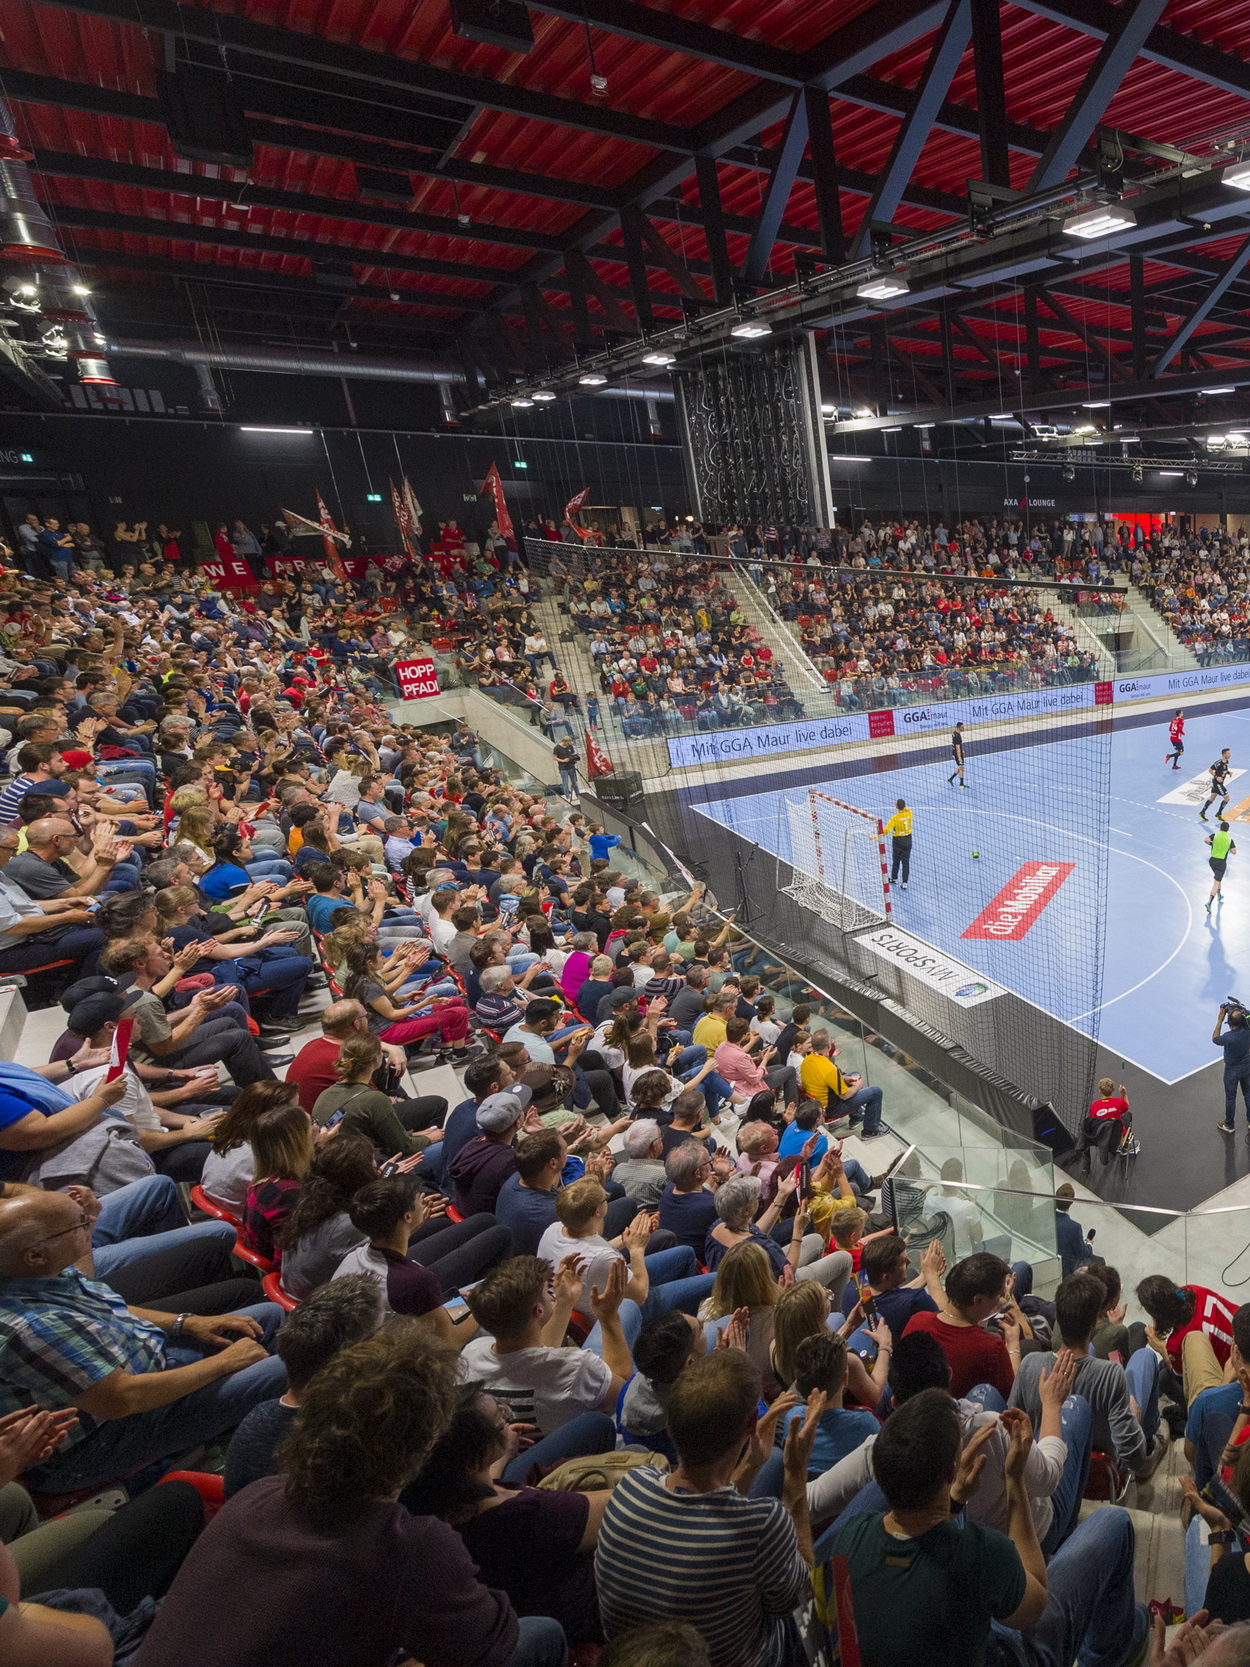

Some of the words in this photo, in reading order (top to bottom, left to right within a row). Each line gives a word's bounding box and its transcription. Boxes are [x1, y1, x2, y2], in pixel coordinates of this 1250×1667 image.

[0, 450, 18, 464] NG
[1003, 498, 1019, 507] AXA
[1028, 499, 1056, 507] LOUNGE
[203, 562, 248, 578] WE
[399, 663, 434, 680] HOPP
[1168, 678, 1181, 690] Mit
[1182, 676, 1199, 688] GGA
[1200, 673, 1218, 686] Maur
[1220, 671, 1232, 682] live
[1232, 668, 1250, 680] dabei
[403, 680, 440, 697] PFADI
[1119, 683, 1137, 693] GGA
[972, 705, 988, 718] Mit
[991, 702, 1014, 716] GGA
[1016, 699, 1040, 713] Maur
[1043, 696, 1058, 708] live
[1060, 692, 1084, 706] dabei
[903, 711, 928, 723] GGA
[691, 741, 716, 758] Mit
[720, 737, 752, 754] GGA
[757, 733, 790, 749] Maur
[796, 728, 816, 743] live
[820, 723, 852, 740] dabei
[997, 864, 1060, 914] Mobiliar
[982, 913, 1022, 935] die
[871, 934, 959, 982] MYSPORTS
